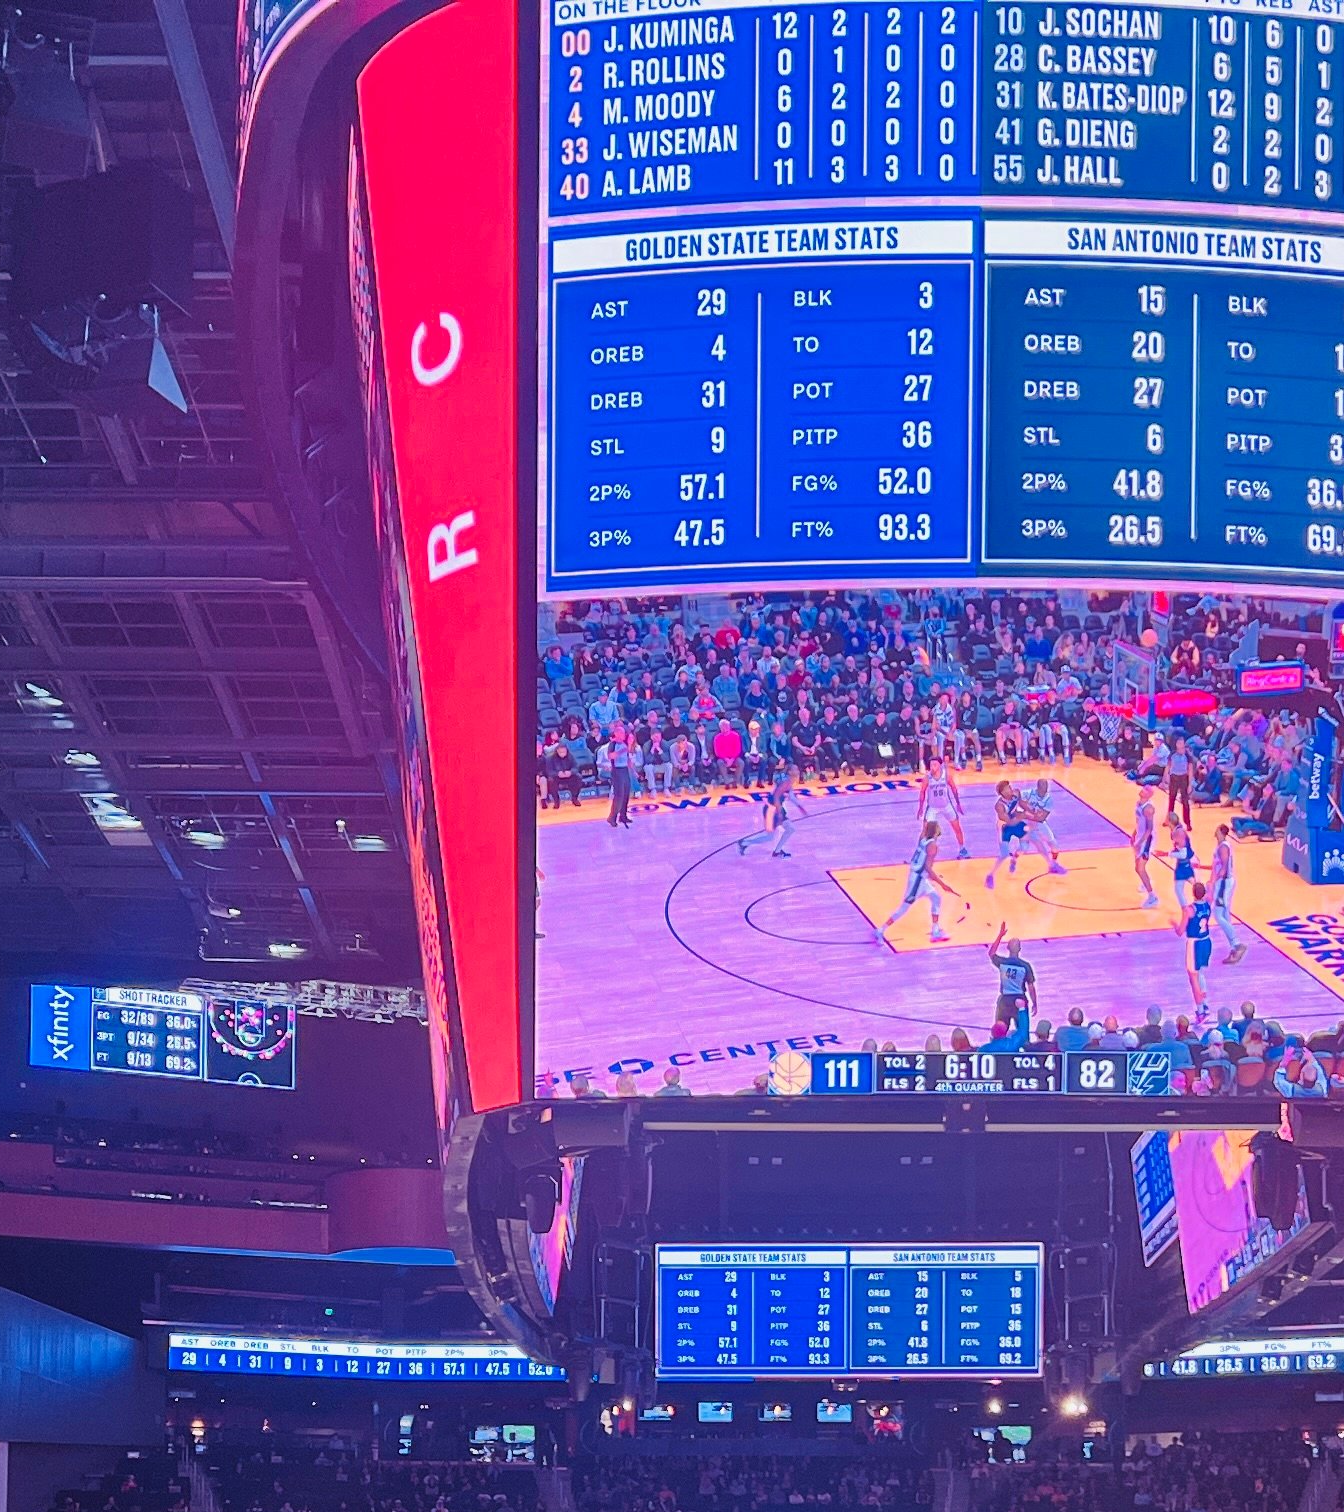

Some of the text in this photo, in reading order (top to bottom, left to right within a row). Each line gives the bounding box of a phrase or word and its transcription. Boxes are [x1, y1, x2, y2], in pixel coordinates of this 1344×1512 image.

[559, 0, 629, 19] ON THE
[1308, 0, 1344, 14] AST
[560, 16, 735, 58] 00 J. KUMINGA
[995, 7, 1161, 40] 10 J. SOCHAN
[568, 52, 725, 93] 2 R. ROLLINS
[994, 44, 1156, 76] 28 C. BASSEY
[567, 90, 715, 128] 4 M. MOODY
[995, 81, 1185, 115] 31 K. BATES-DIOP
[561, 124, 739, 165] 33 J. WISEMAN
[995, 118, 1137, 149] 41 G. DIENG
[560, 164, 691, 200] 40 A. LAMB
[993, 154, 1123, 186] 55 J. HALL
[625, 226, 899, 262] GOLDEN STATE TEAM STATS
[1067, 227, 1322, 263] SAN ANTONIO TEAM STATS
[590, 288, 726, 319] AST 29
[793, 281, 934, 309] BLK 3
[1024, 285, 1165, 314] AST 15
[590, 334, 727, 364] OREB 4
[793, 327, 934, 356] TO 12
[1023, 331, 1164, 361] OREB 20
[590, 380, 726, 411] DREB 31
[792, 374, 933, 402] POT 27
[1023, 377, 1164, 407] DREB 27
[590, 426, 725, 456] STL 9
[792, 420, 933, 448] PITP 36
[1023, 423, 1163, 454] STL 6
[589, 472, 726, 502] 2P% 57.1
[792, 466, 932, 495] FG% 52.0
[1021, 469, 1163, 499] 2P% 41.8
[589, 519, 726, 547] 3P% 47.5
[791, 513, 931, 541] FT% 93.3
[1021, 515, 1163, 545] 3P% 26.5
[119, 989, 188, 1006] SHOT TRACKER
[824, 1060, 859, 1088] 111
[884, 1055, 926, 1070] TOL 2
[944, 1055, 996, 1079] 6:10
[1013, 1055, 1054, 1070] TOL 4
[1079, 1060, 1114, 1088] 82
[884, 1075, 926, 1091] FLS 2
[955, 1082, 1004, 1092] QUARTER
[1013, 1075, 1054, 1091] FLS 1
